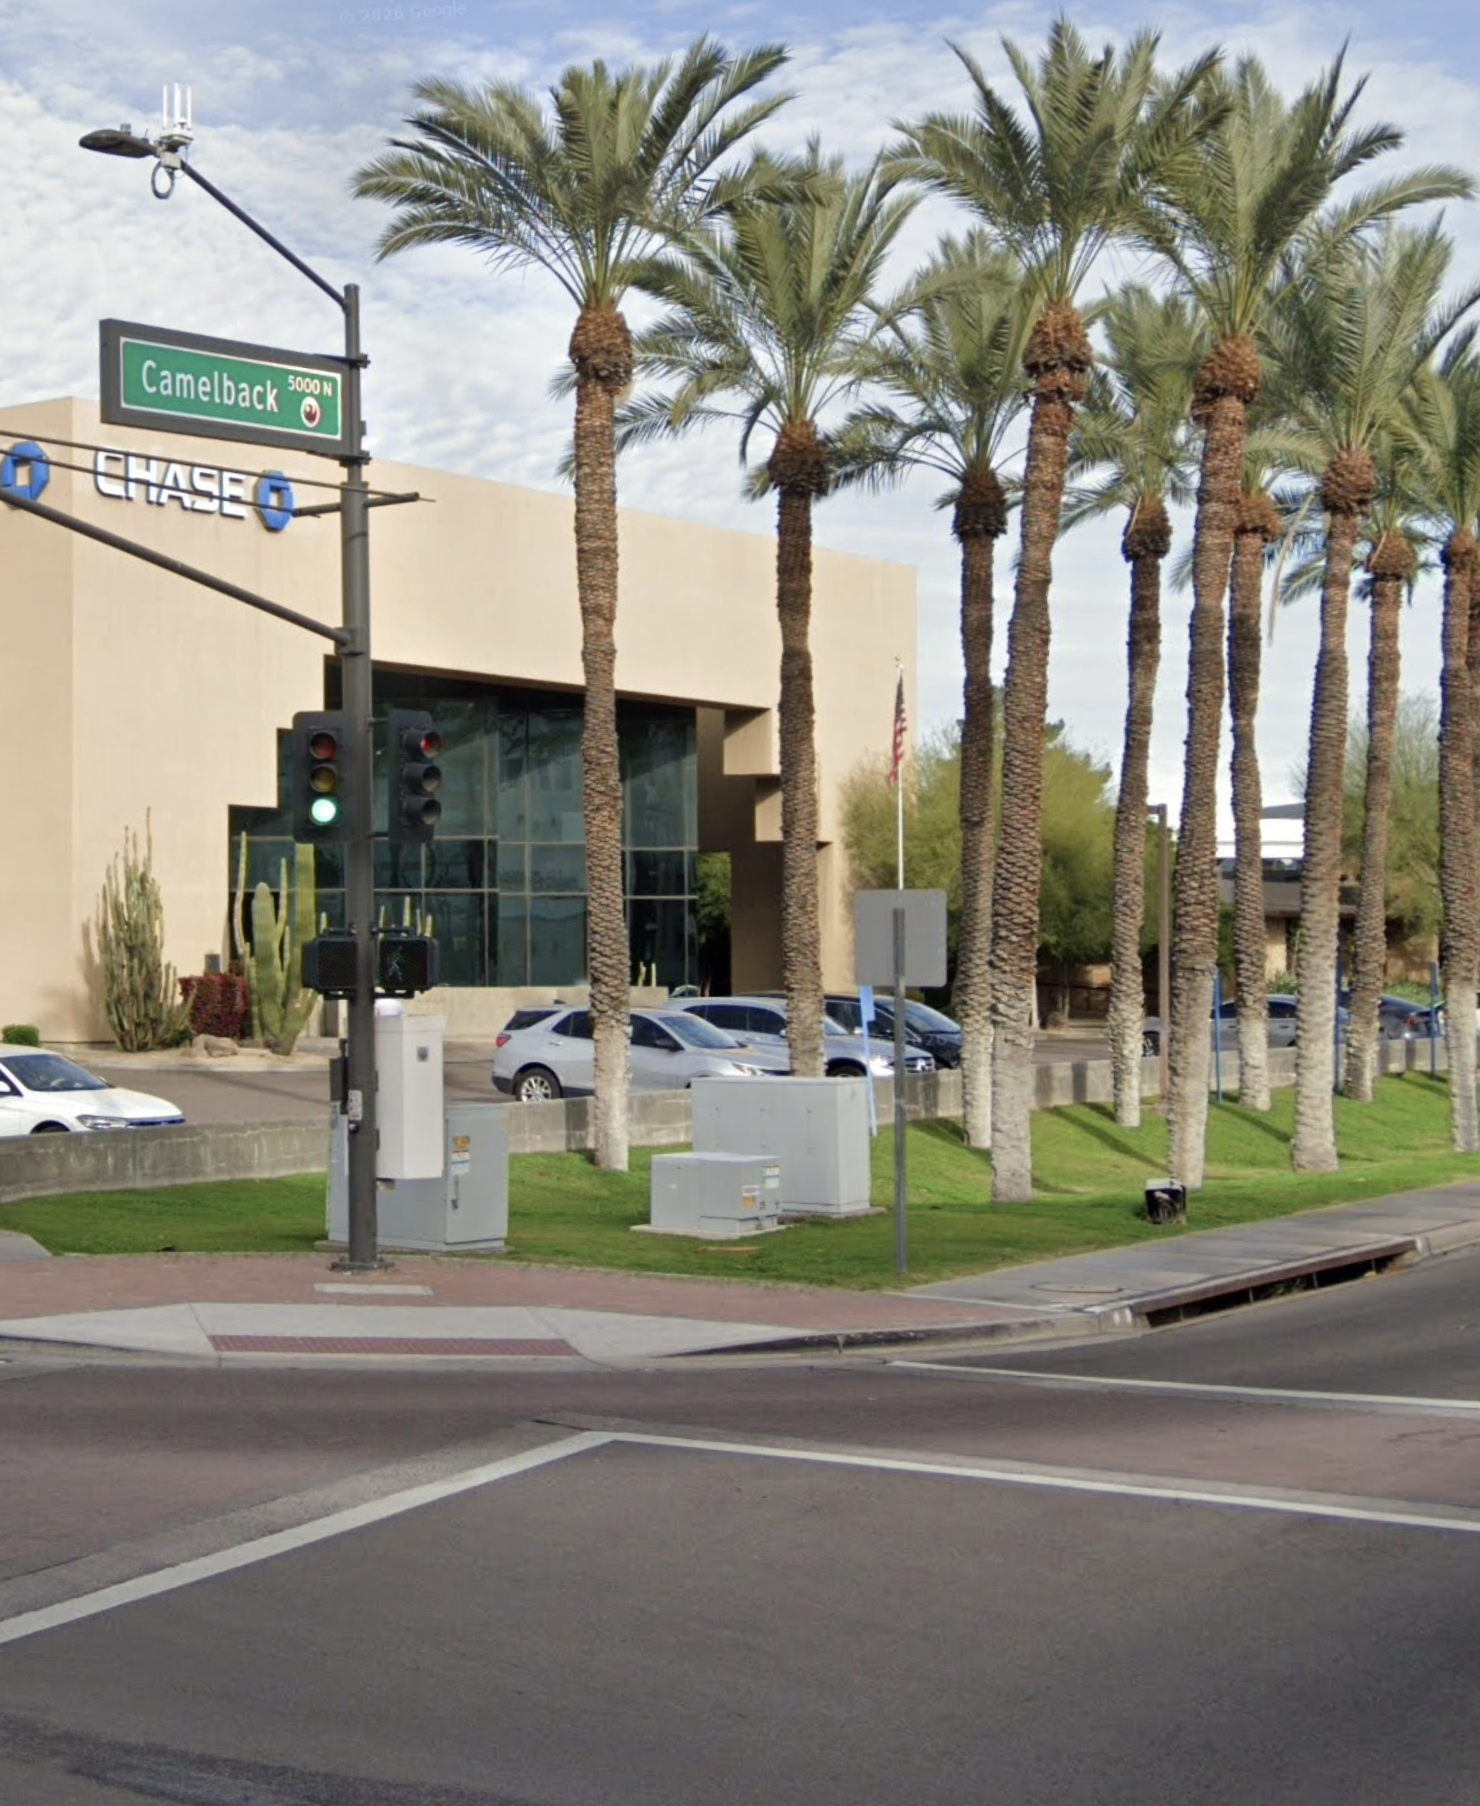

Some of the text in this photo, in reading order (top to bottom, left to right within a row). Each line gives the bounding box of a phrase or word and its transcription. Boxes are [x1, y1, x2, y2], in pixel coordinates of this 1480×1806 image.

[141, 359, 279, 413] Camelback
[288, 375, 333, 397] 5000 N
[94, 448, 249, 519] CHASE
